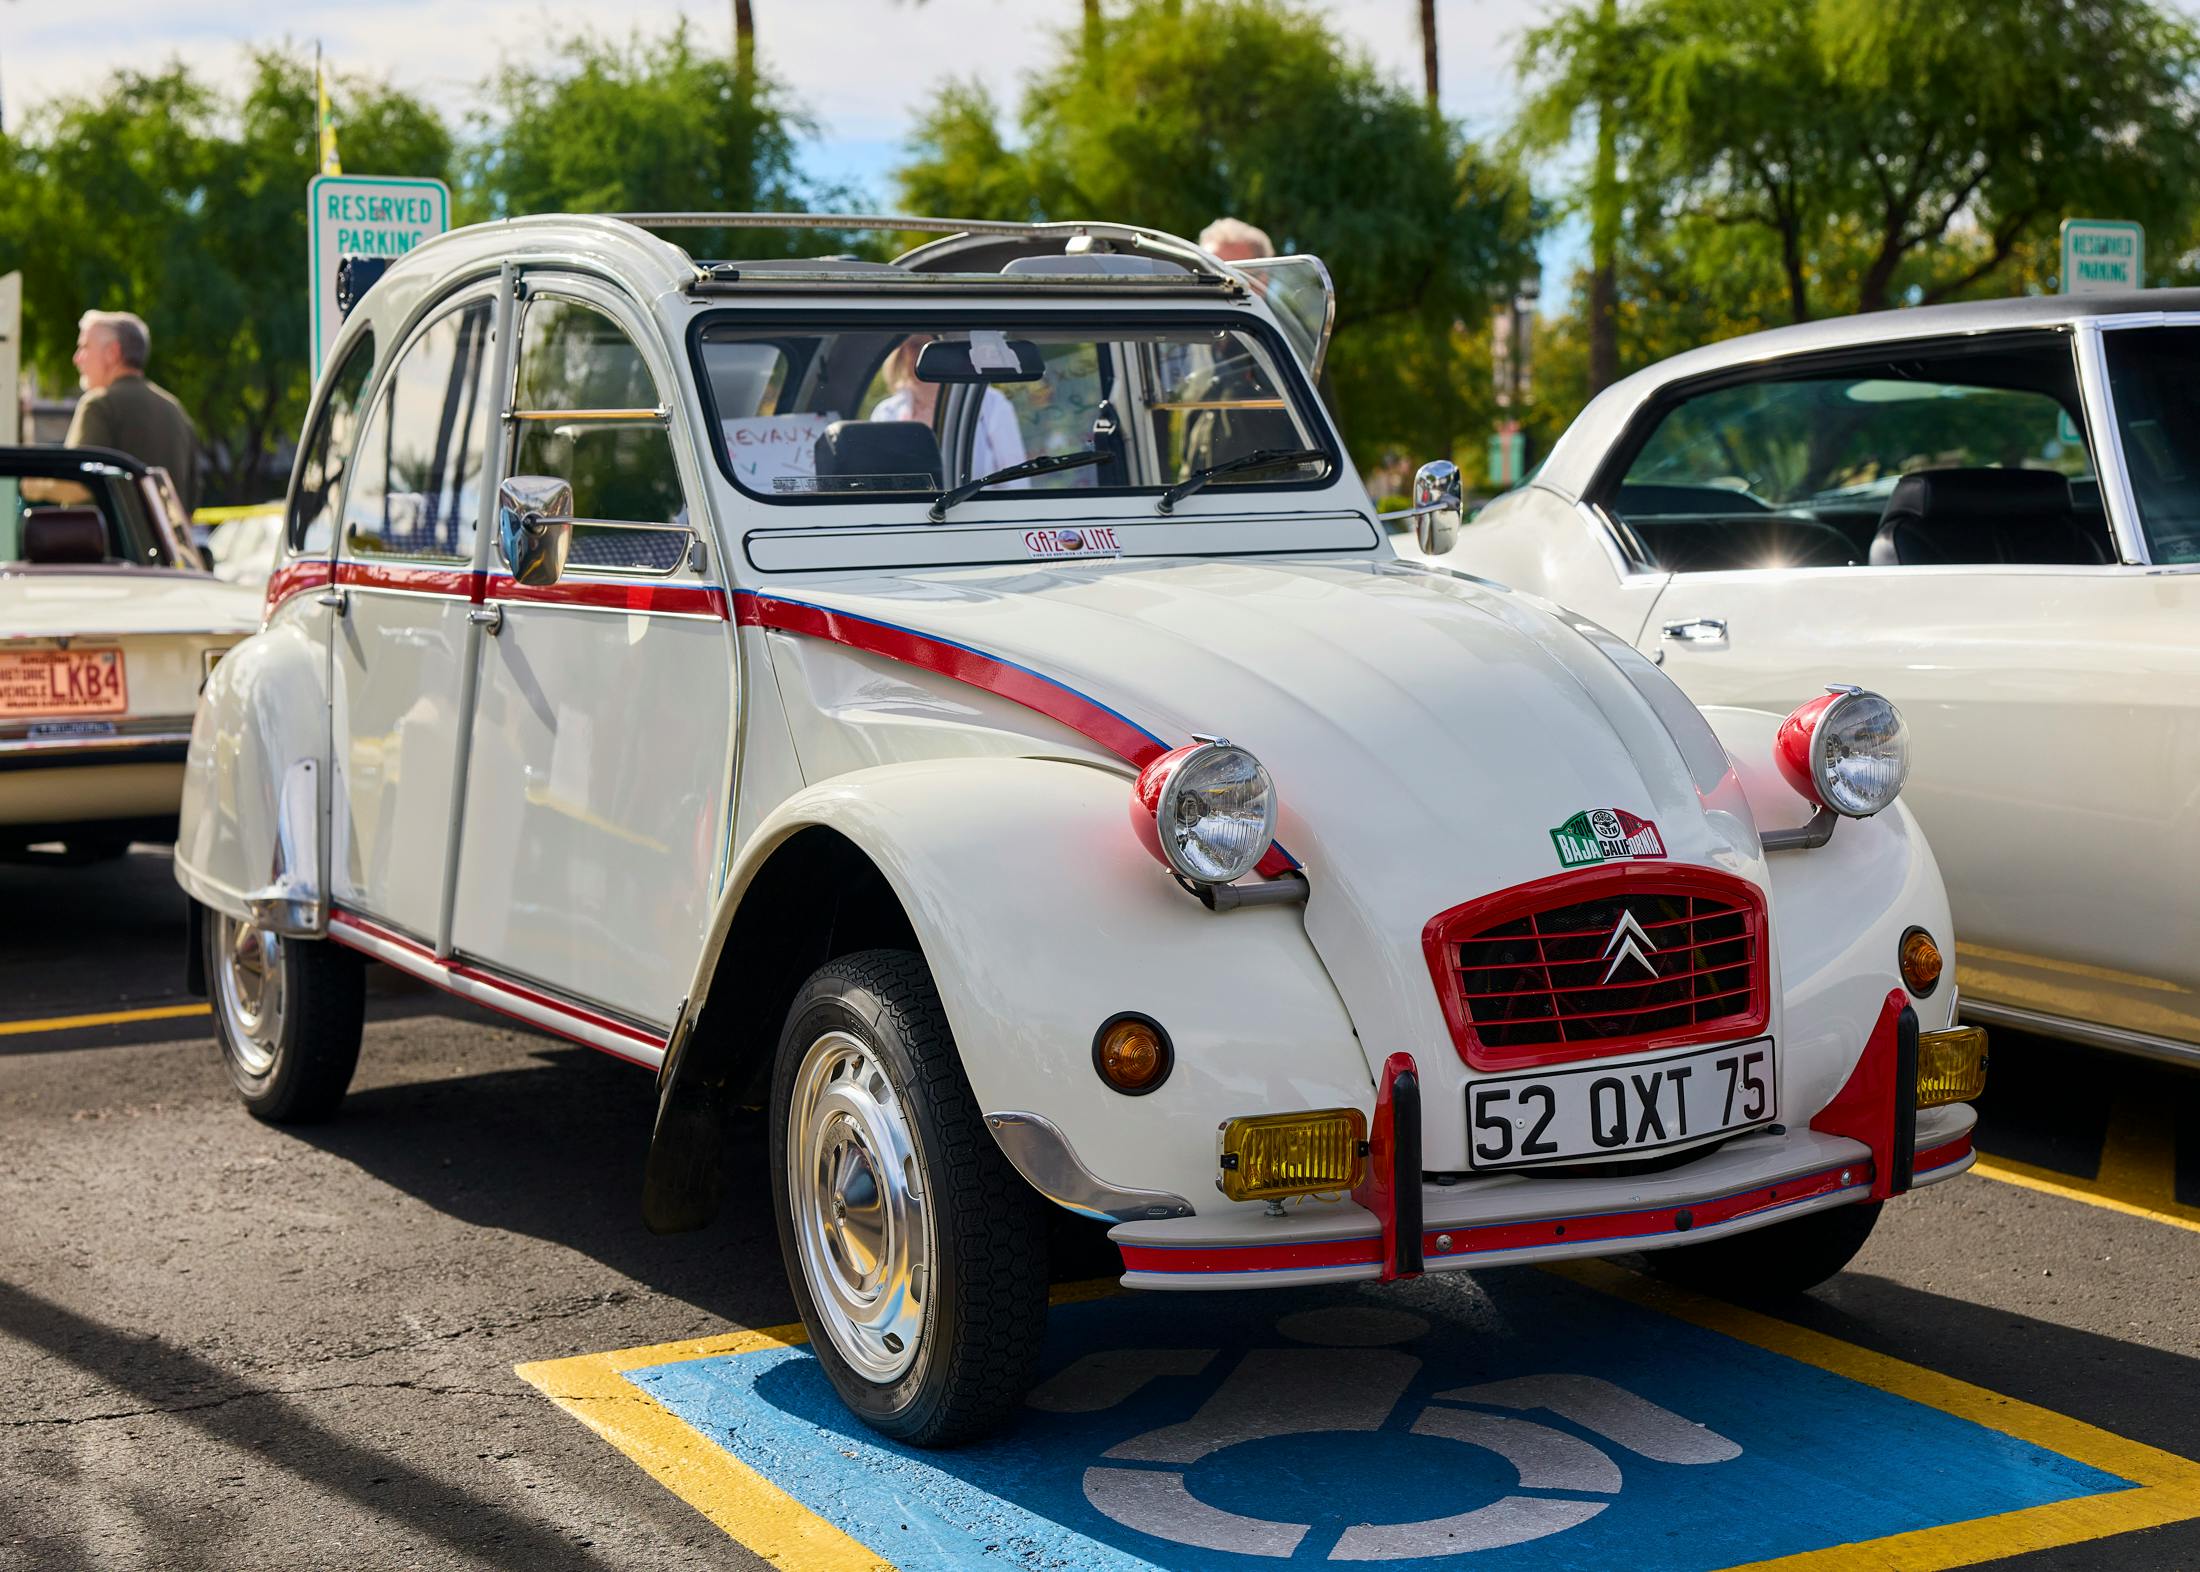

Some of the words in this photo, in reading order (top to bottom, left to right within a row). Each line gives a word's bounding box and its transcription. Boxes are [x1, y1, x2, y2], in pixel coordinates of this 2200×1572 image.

[327, 194, 432, 223] RESERVED
[50, 661, 119, 698] LKB4
[1557, 834, 1601, 863] BAJA
[1599, 827, 1663, 857] CALIFORNIA
[1475, 1084, 1558, 1160] 52
[1589, 1066, 1693, 1148] QXT
[1716, 1051, 1765, 1127] 75
